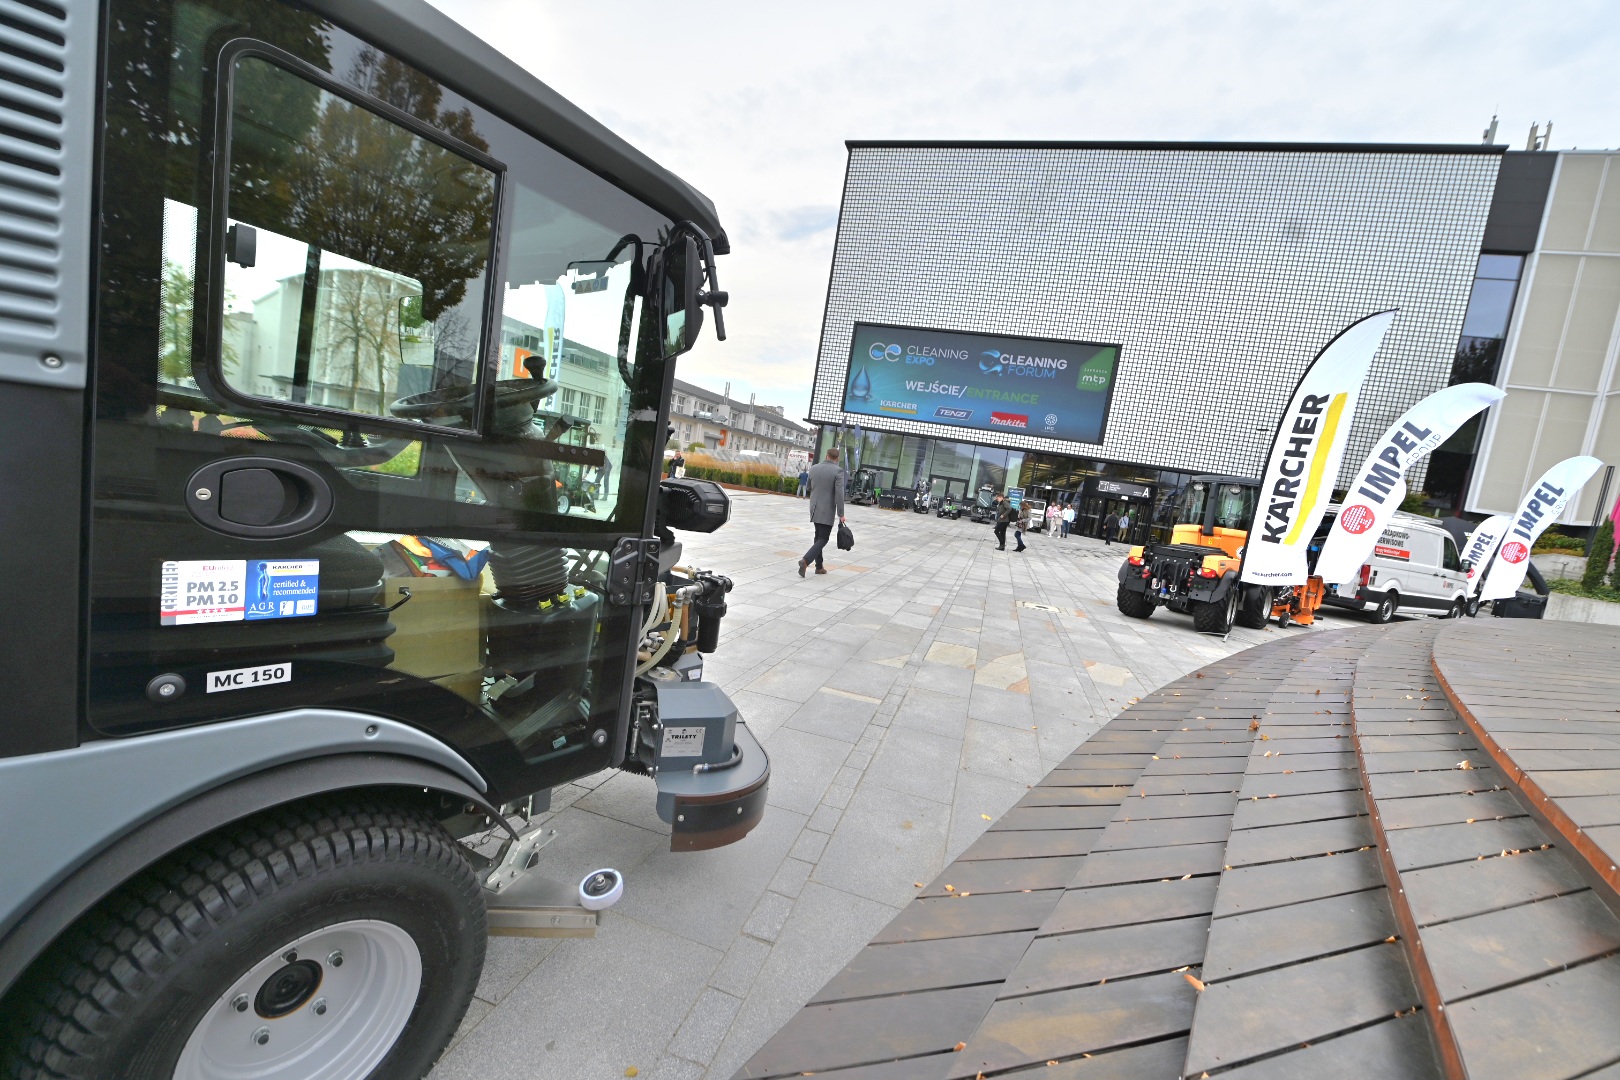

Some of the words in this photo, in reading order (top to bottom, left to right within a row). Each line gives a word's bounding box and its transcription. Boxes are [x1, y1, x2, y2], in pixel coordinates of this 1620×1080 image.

[907, 345, 969, 360] CLEANING
[905, 355, 935, 366] EXPO
[1000, 353, 1068, 370] CLEANING
[1007, 365, 1057, 379] FORUM
[1082, 374, 1106, 385] mtp
[940, 409, 967, 418] TENZI
[1261, 393, 1330, 544] KÄRCHER
[1358, 420, 1433, 505] IMPEL
[1142, 487, 1149, 498] A
[1513, 481, 1565, 541] IMPEL
[1468, 532, 1494, 567] IMPEL
[187, 582, 215, 593] PM
[218, 581, 239, 592] 2.5
[273, 579, 299, 588] certified
[273, 586, 316, 596] recommended
[186, 595, 214, 607] PM
[218, 594, 238, 605] 10
[214, 672, 244, 688] MC
[251, 667, 285, 683] 150
